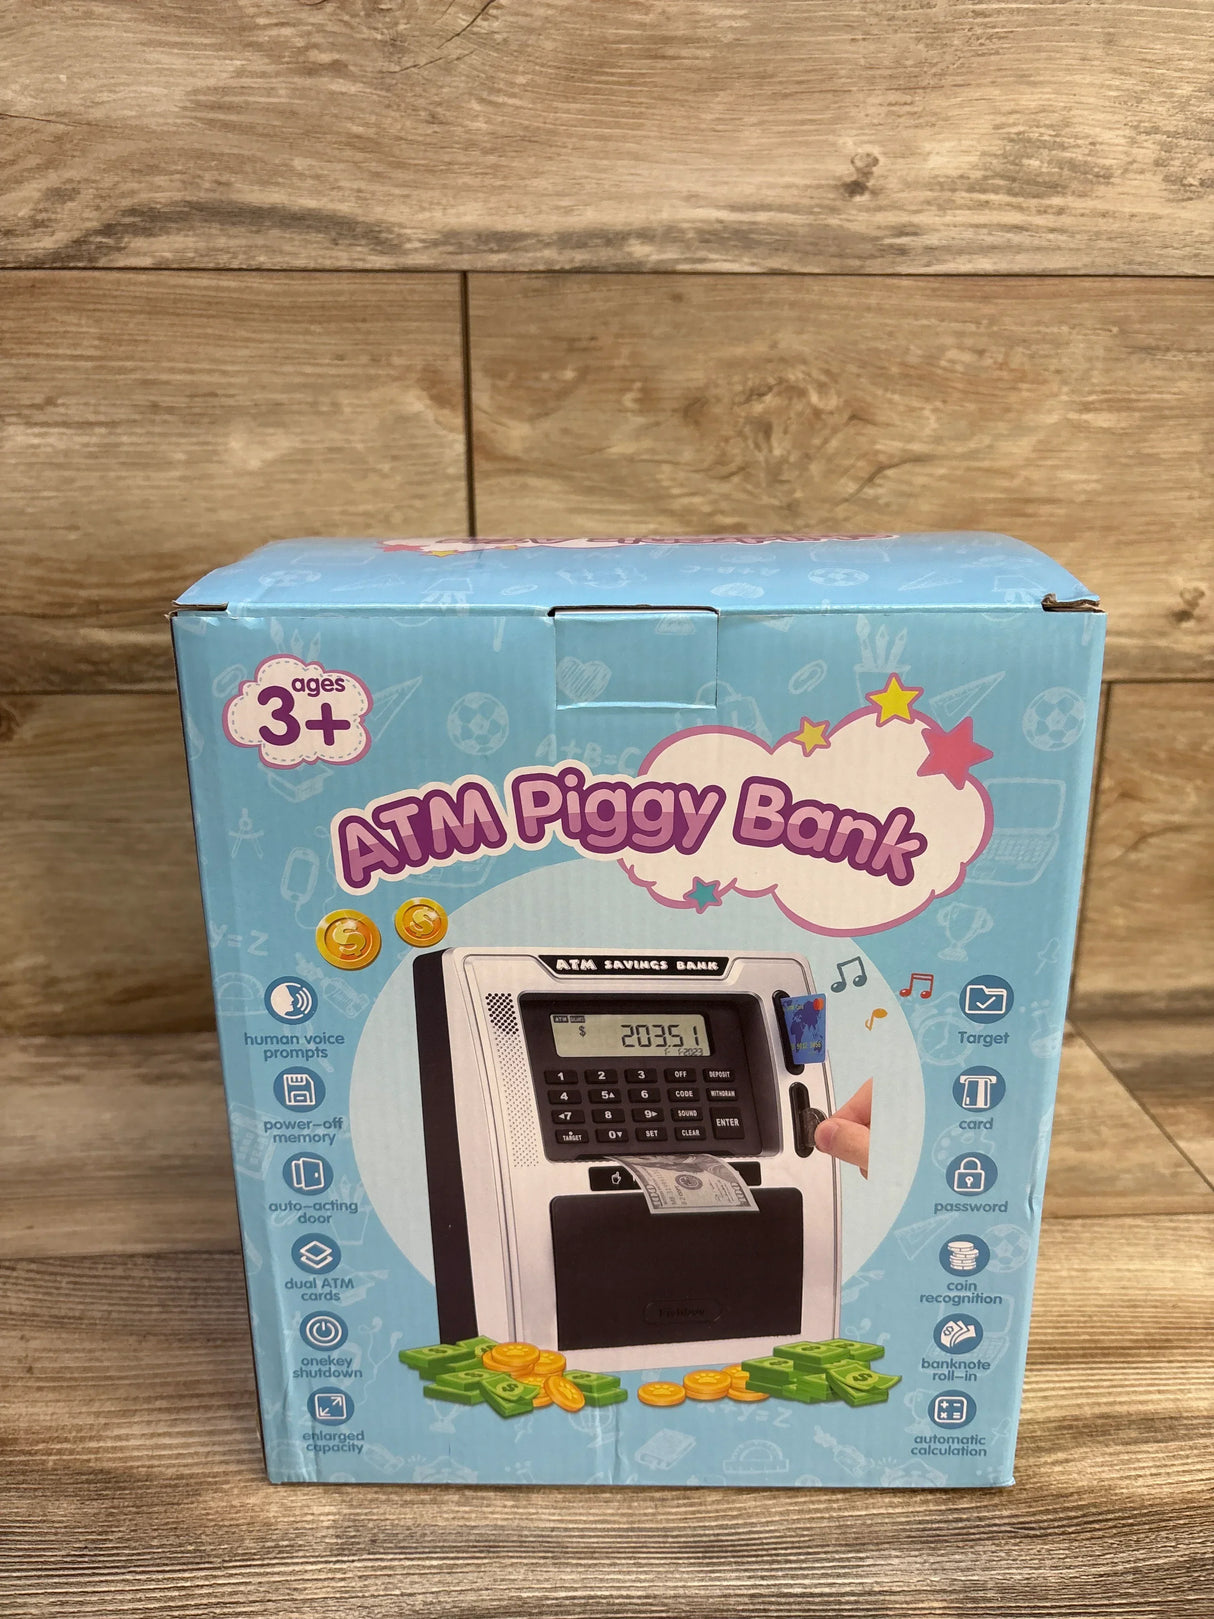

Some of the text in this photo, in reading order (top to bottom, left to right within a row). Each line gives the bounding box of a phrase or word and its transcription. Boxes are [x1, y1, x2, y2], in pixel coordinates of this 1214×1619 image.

[291, 677, 346, 697] ages
[257, 685, 351, 746] 3+
[338, 767, 928, 888] ATM Piggy Bank
[556, 959, 719, 971] ATM SAVINGS BANK
[244, 1032, 345, 1045] human voice
[958, 1031, 1010, 1047] Target
[263, 1046, 329, 1061] prompts
[557, 1073, 564, 1081] 1
[637, 1071, 646, 1079] 3
[560, 1092, 569, 1101] 4
[640, 1090, 649, 1098] 6
[675, 1090, 693, 1098] CODE
[604, 1111, 612, 1119] 8
[716, 1119, 740, 1127] ENTER
[958, 1117, 994, 1130] card
[273, 1132, 336, 1146] memory
[645, 1129, 659, 1137] SET
[934, 1201, 1008, 1215] password
[298, 1212, 332, 1224] door
[285, 1278, 355, 1289] dual ATM
[946, 1280, 977, 1292] coin
[301, 1290, 341, 1301] cards
[919, 1293, 1003, 1306] recognition
[301, 1355, 353, 1369] onekey
[921, 1358, 991, 1371] banknote
[293, 1367, 363, 1378] shutdown
[302, 1430, 365, 1443] enlarged
[914, 1434, 987, 1446] automatic
[306, 1441, 364, 1454] capacity
[910, 1446, 988, 1457] calculation
